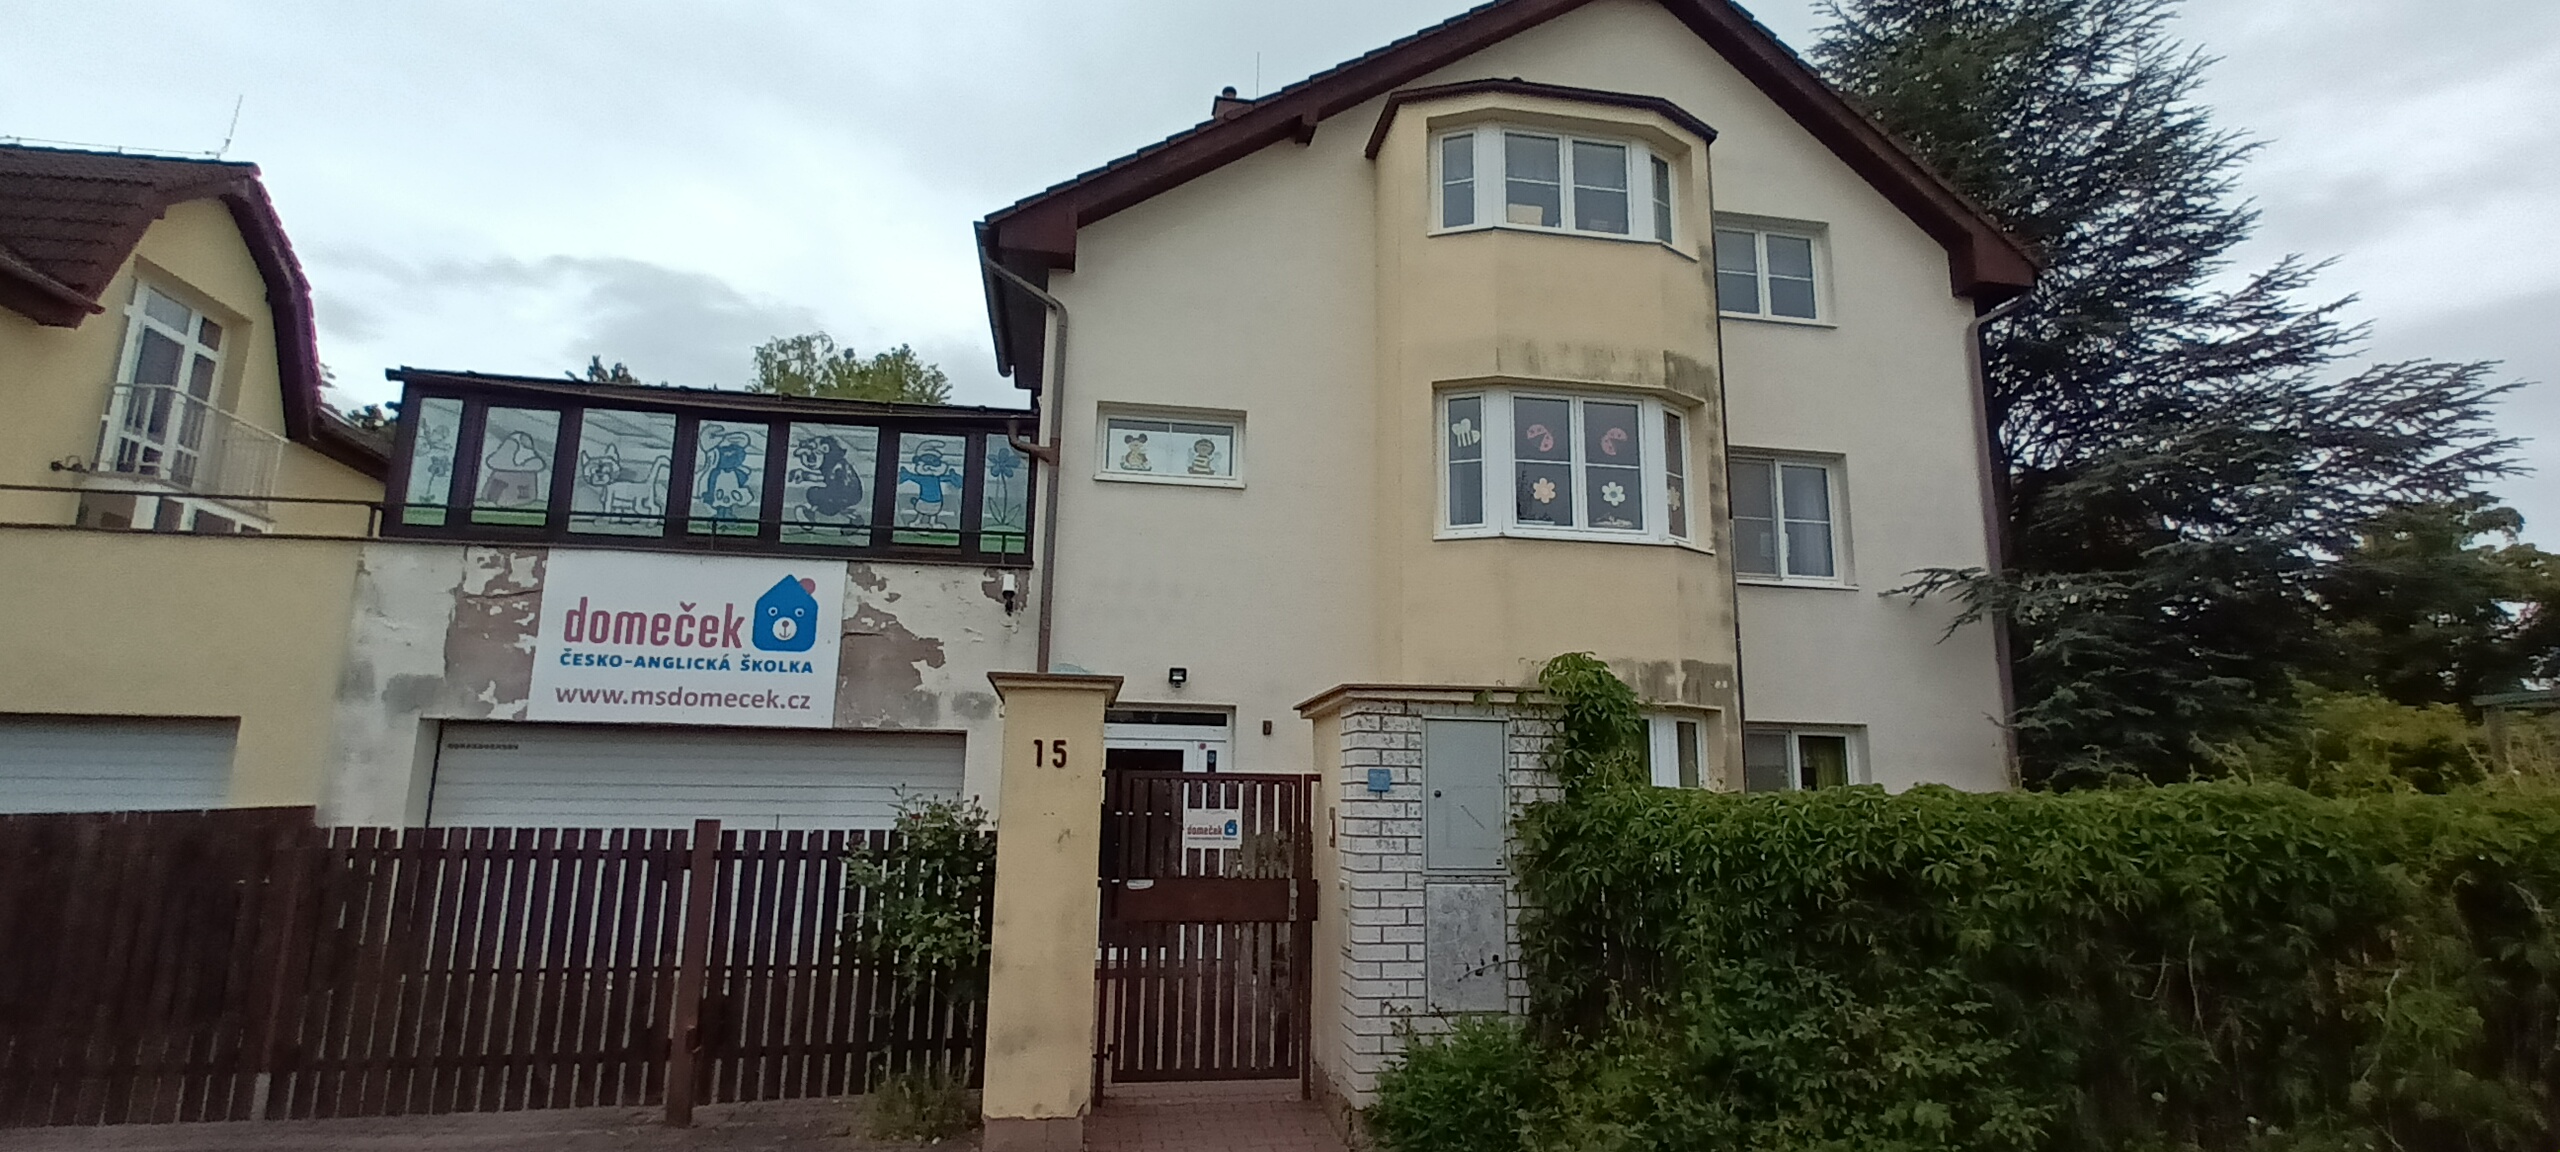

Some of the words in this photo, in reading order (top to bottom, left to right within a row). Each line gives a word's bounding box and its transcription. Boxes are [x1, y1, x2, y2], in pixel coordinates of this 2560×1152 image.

[563, 596, 745, 648] domeček
[559, 649, 731, 671] ČESKO-ANGLICKÁ
[740, 654, 813, 673] ŠKOLKA
[555, 685, 811, 709] www.msdomecek.cz
[1033, 739, 1067, 768] 15
